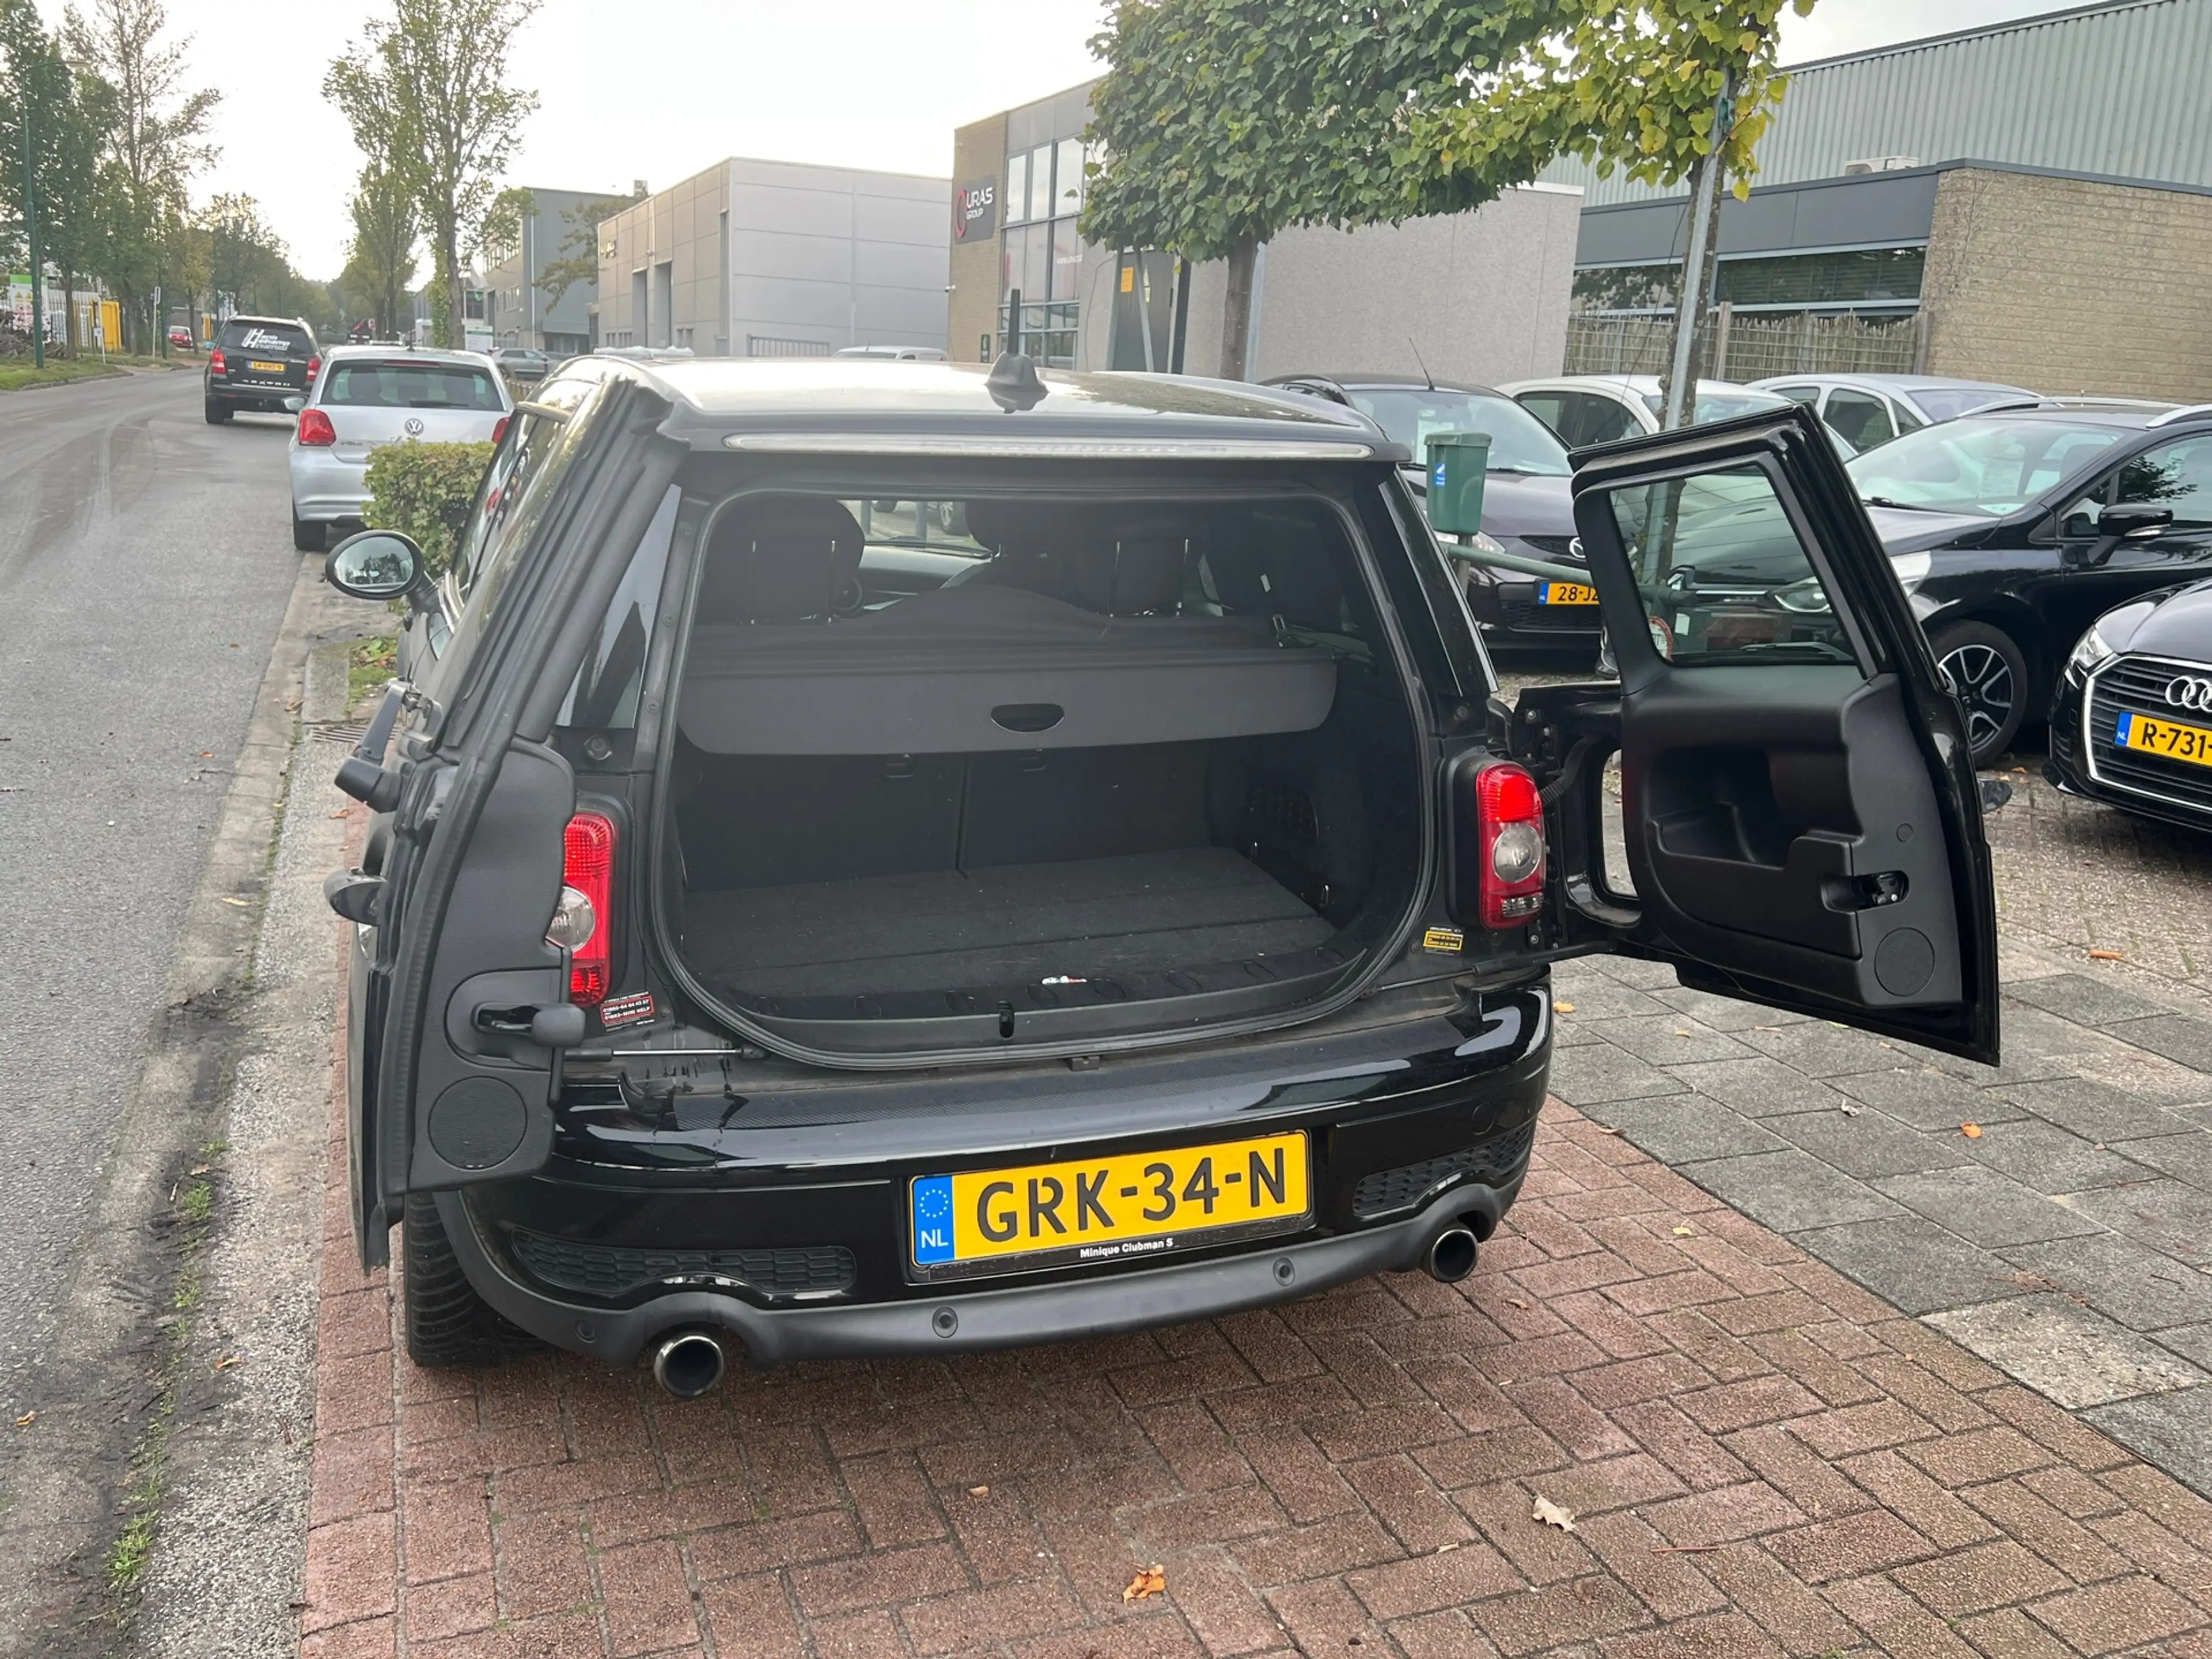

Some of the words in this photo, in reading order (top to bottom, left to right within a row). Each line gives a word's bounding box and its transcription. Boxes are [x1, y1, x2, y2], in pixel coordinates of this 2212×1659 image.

[966, 208, 984, 219] GROUP
[2117, 731, 2127, 741] NL
[921, 1229, 949, 1248] NL
[977, 1147, 1287, 1243] GRK-34-N
[1080, 1247, 1120, 1258] Minique
[1122, 1240, 1164, 1253] Clubman
[1166, 1237, 1173, 1247] S
